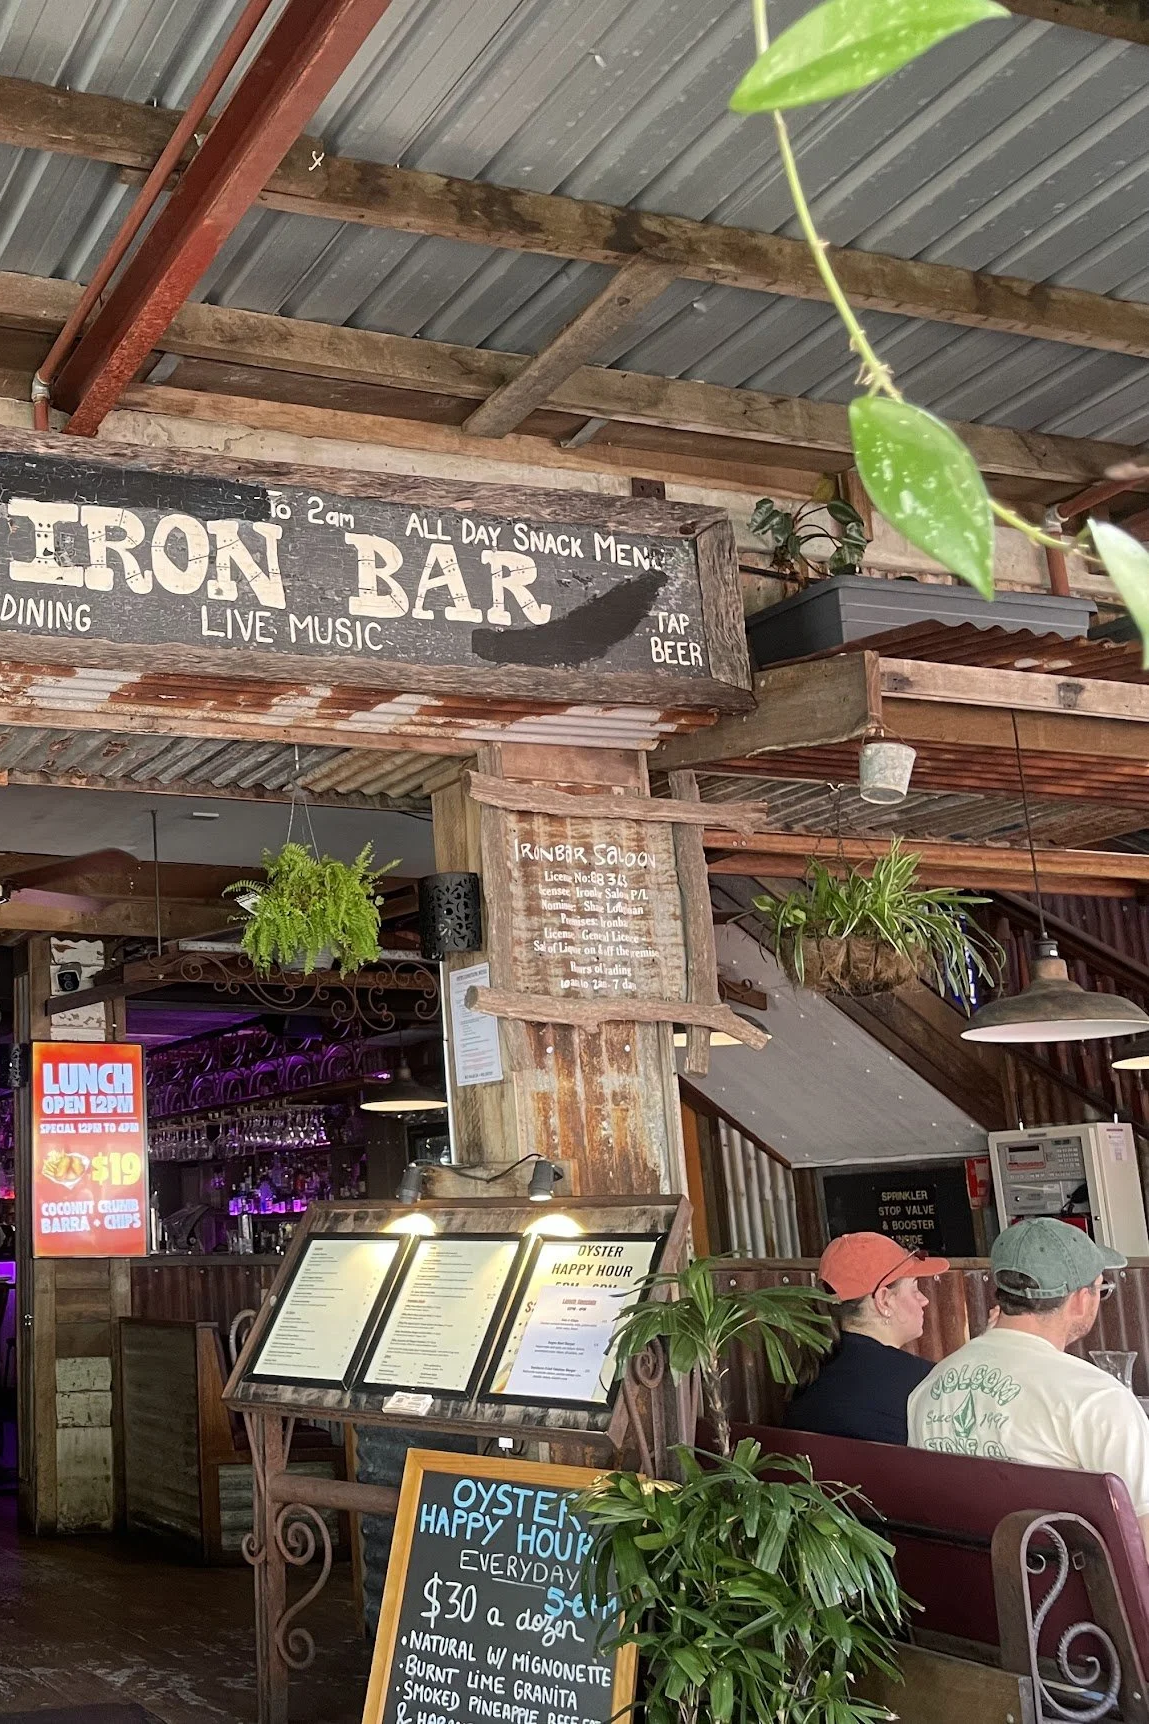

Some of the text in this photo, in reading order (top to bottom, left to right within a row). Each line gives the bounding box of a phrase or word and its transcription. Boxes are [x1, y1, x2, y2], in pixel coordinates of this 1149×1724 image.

[307, 496, 355, 529] 2am
[405, 512, 451, 542] ALL
[461, 517, 502, 547] DAY
[513, 523, 585, 559] SNACK
[7, 498, 552, 627] IRON BAR
[1, 593, 91, 632] DINING
[201, 605, 383, 651] LIVE MUSIC
[658, 612, 690, 636] TAP
[650, 636, 703, 667] BEER
[42, 1063, 134, 1094] LUNCH
[42, 1095, 134, 1114] OPEN 12PM
[40, 1123, 76, 1134] SPECIAL
[78, 1123, 102, 1133] 12PM
[104, 1123, 116, 1133] TO
[91, 1152, 142, 1186] $19
[41, 1199, 139, 1217] COCONUT CRUMB
[878, 1204, 935, 1216] STOP VALVE
[881, 1190, 928, 1201] SPRINKLER
[40, 1216, 90, 1234] BARRA
[104, 1214, 142, 1229] CHIPS
[882, 1220, 935, 1230] & BOOSTER
[578, 1245, 624, 1258] OYSTER
[551, 1263, 633, 1278] HAPPY HOUR
[419, 1503, 594, 1565] HAPPY HOUR
[459, 1550, 580, 1591] EVERYDAY
[420, 1572, 585, 1647] $30 a dozen
[409, 1630, 477, 1662] NATURAL
[512, 1650, 611, 1687] MIGNONETTE
[403, 1680, 460, 1711] SMOKED
[405, 1655, 578, 1711] BURNT LIME GRANITA
